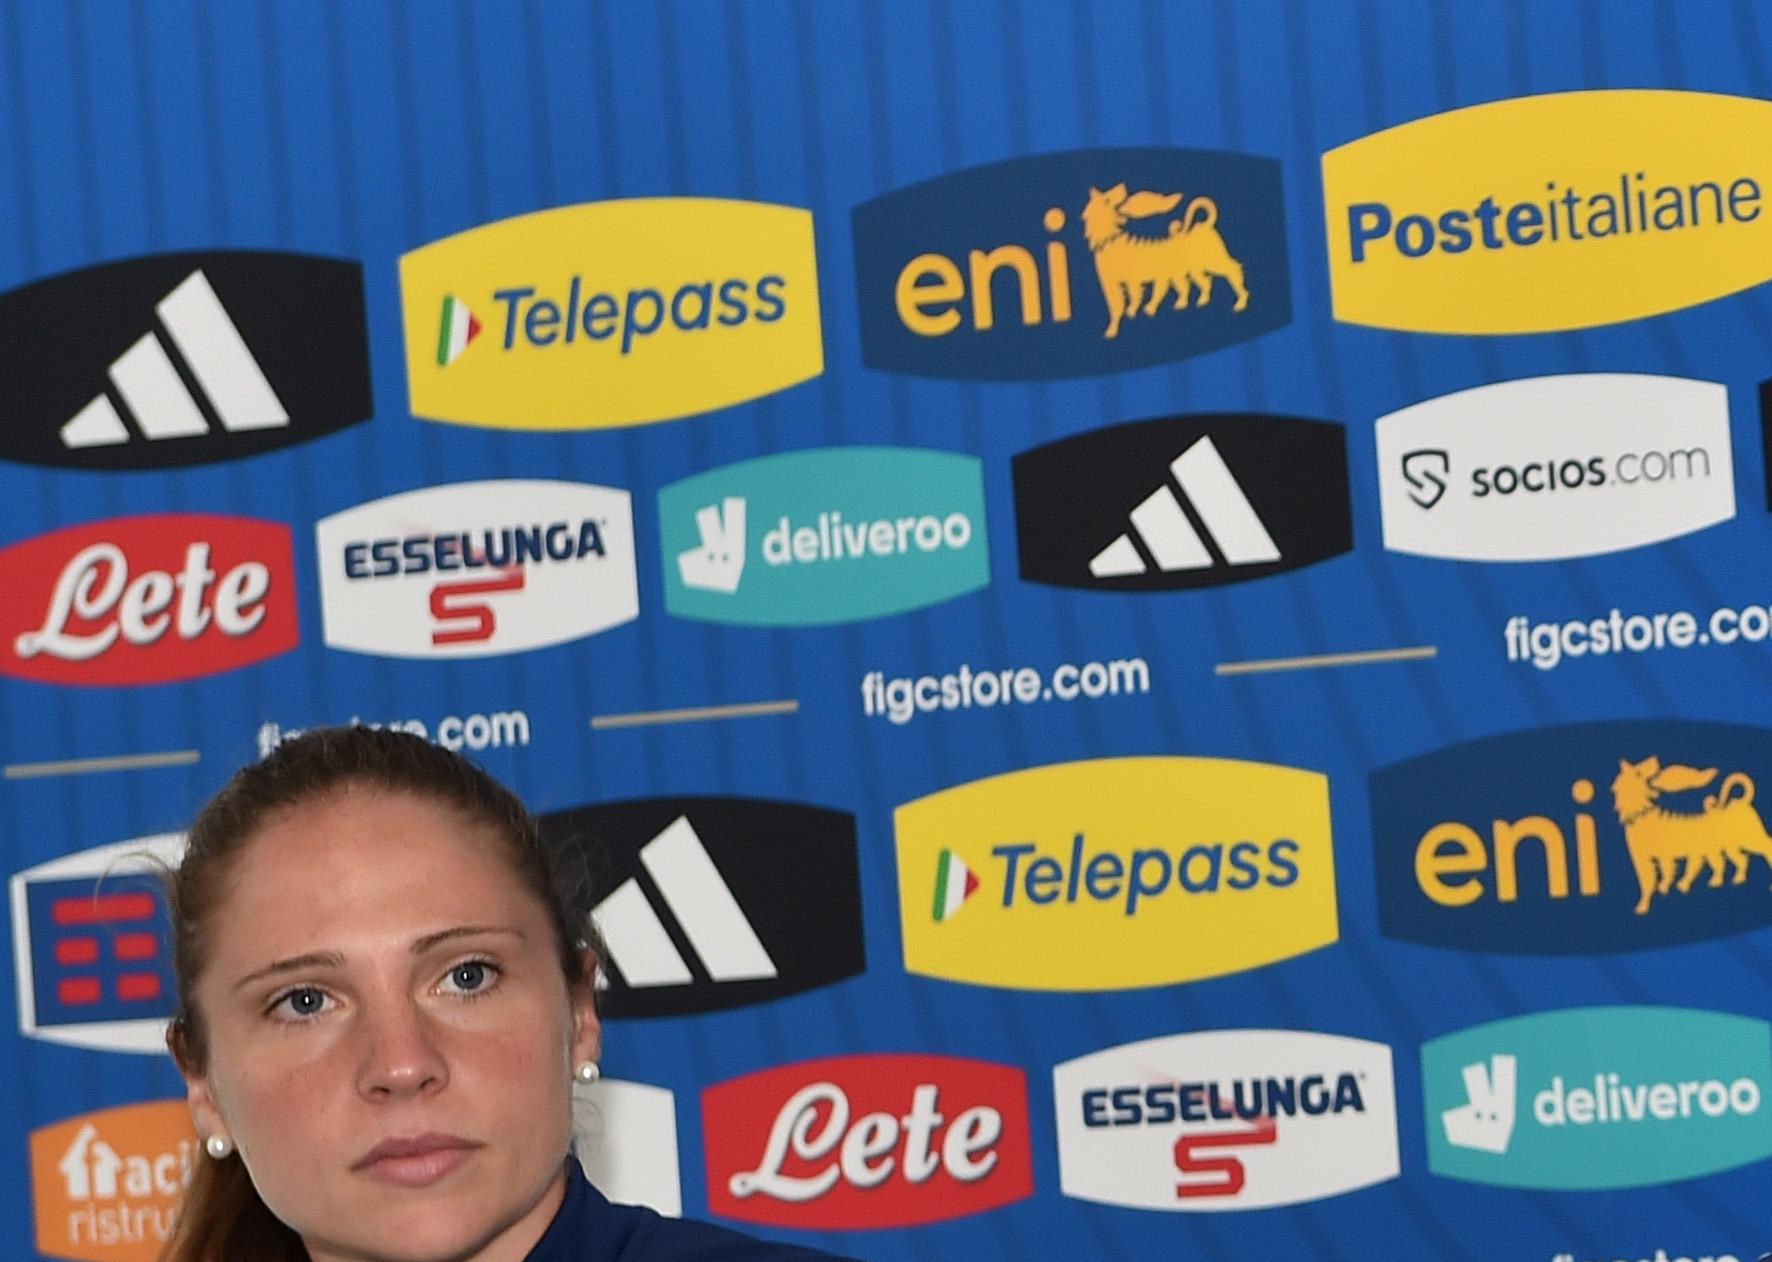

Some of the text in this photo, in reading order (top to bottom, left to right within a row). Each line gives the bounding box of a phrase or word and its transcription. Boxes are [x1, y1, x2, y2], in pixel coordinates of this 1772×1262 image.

[898, 210, 1069, 333] eni
[495, 276, 784, 354] Telepass
[345, 522, 605, 579] ESSELUNGA
[763, 513, 970, 564] deliveroo
[16, 543, 268, 658] Lete
[863, 660, 1149, 722] figcstore.com
[992, 834, 1298, 915] Telepass
[1417, 781, 1598, 904] eni
[1082, 1074, 1364, 1128] ESSELUNGA
[1535, 1074, 1760, 1124] deliveroo
[730, 1084, 1000, 1200] Lete
